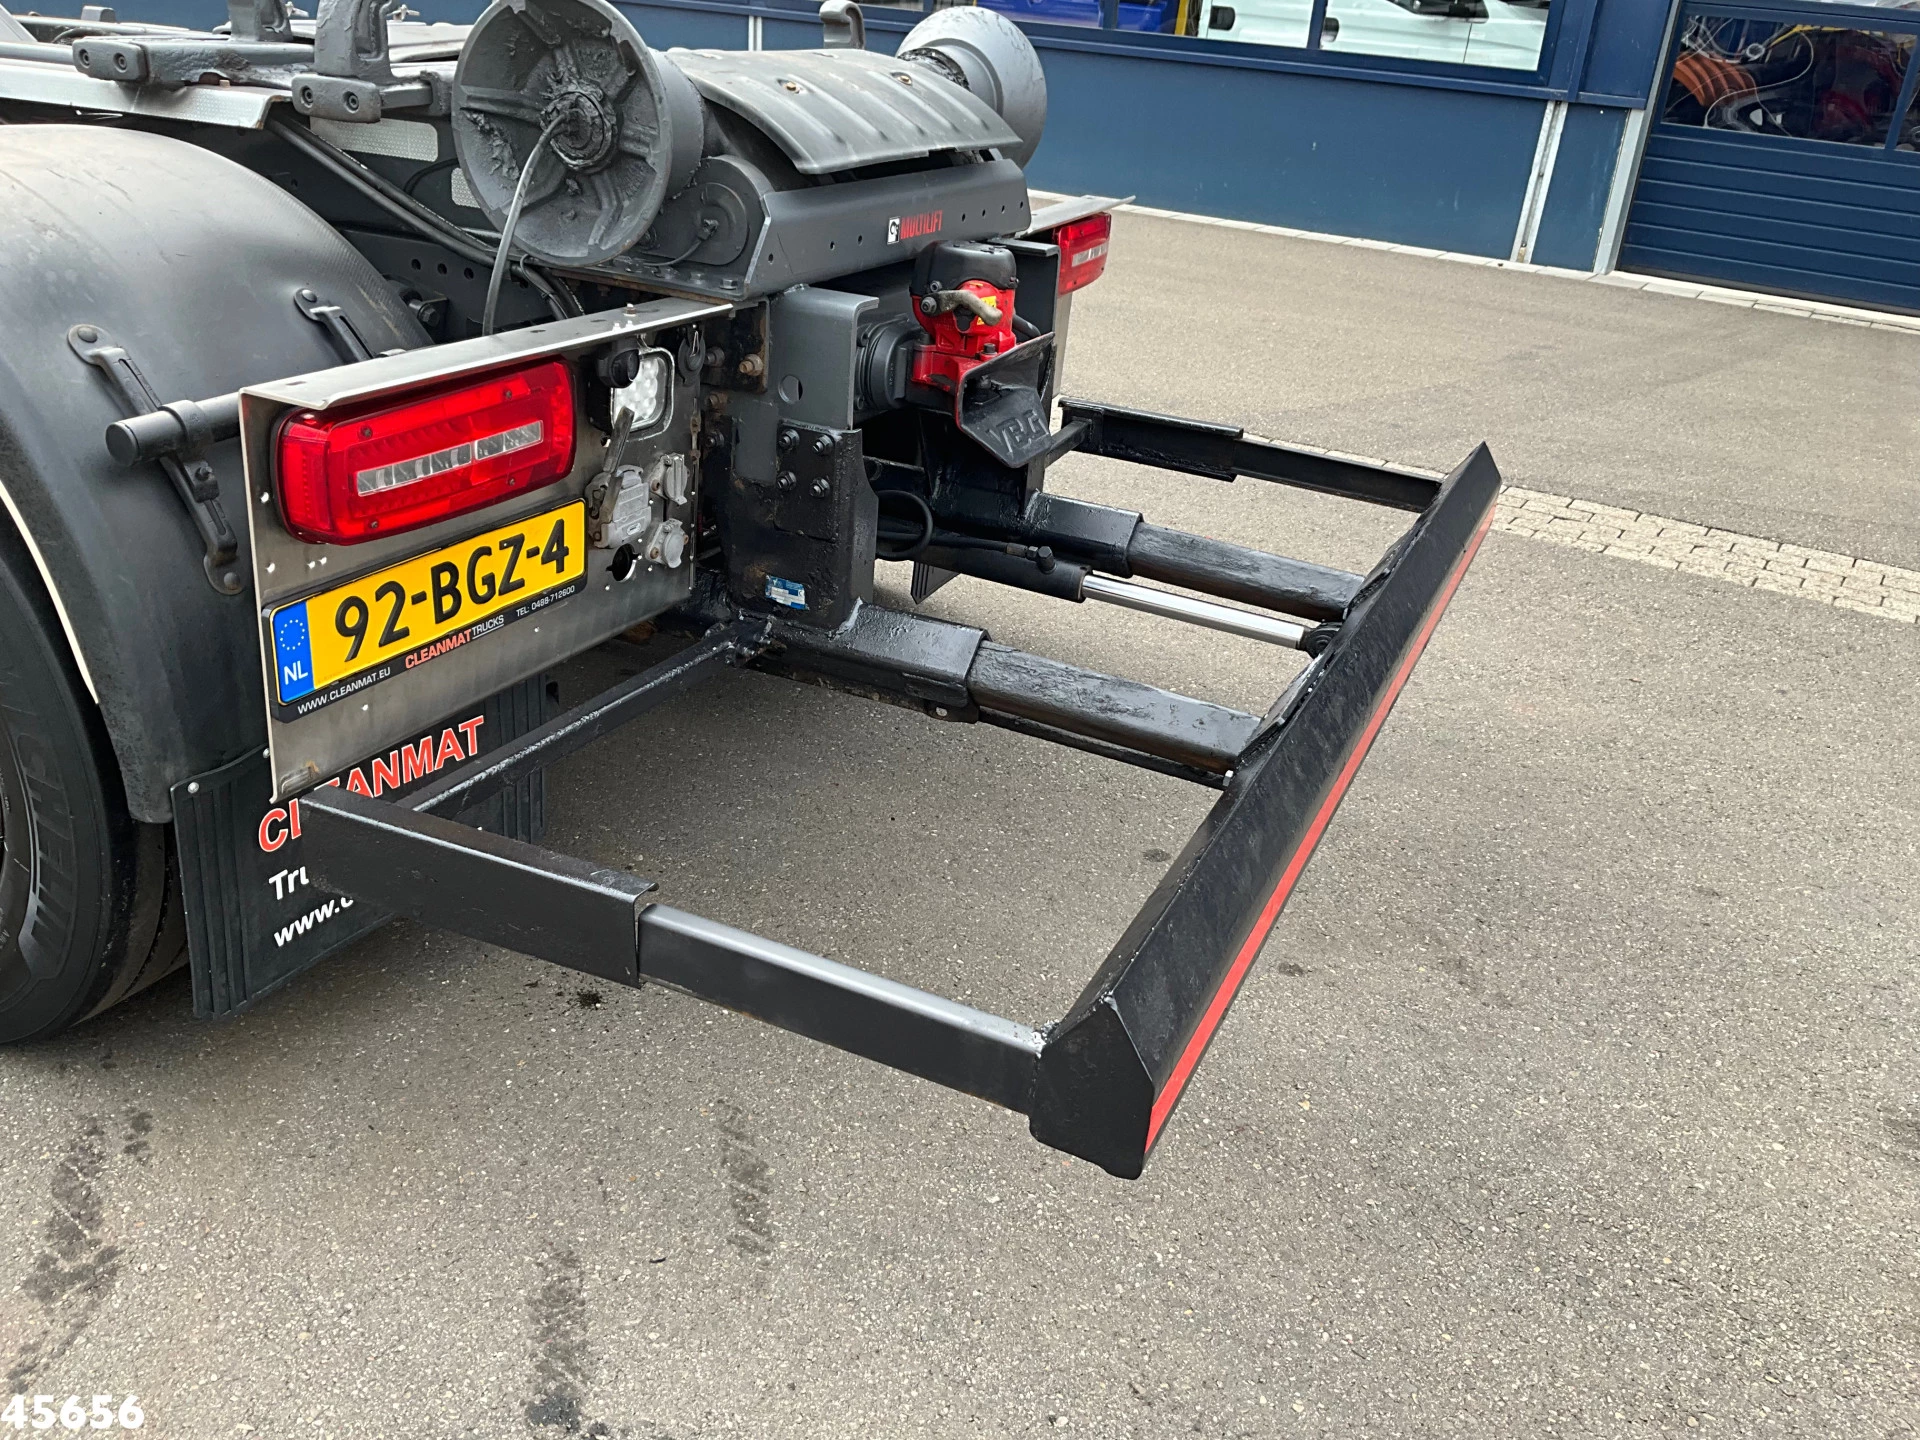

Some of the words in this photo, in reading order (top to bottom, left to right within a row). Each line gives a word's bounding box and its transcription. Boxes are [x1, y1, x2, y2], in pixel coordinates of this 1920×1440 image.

[900, 209, 943, 240] MULTILIFT
[335, 518, 569, 662] 92-BGZ-4
[283, 660, 308, 685] NL
[297, 667, 391, 714] WWW.CLEANMAT.EU
[258, 715, 484, 852] CLANMAT
